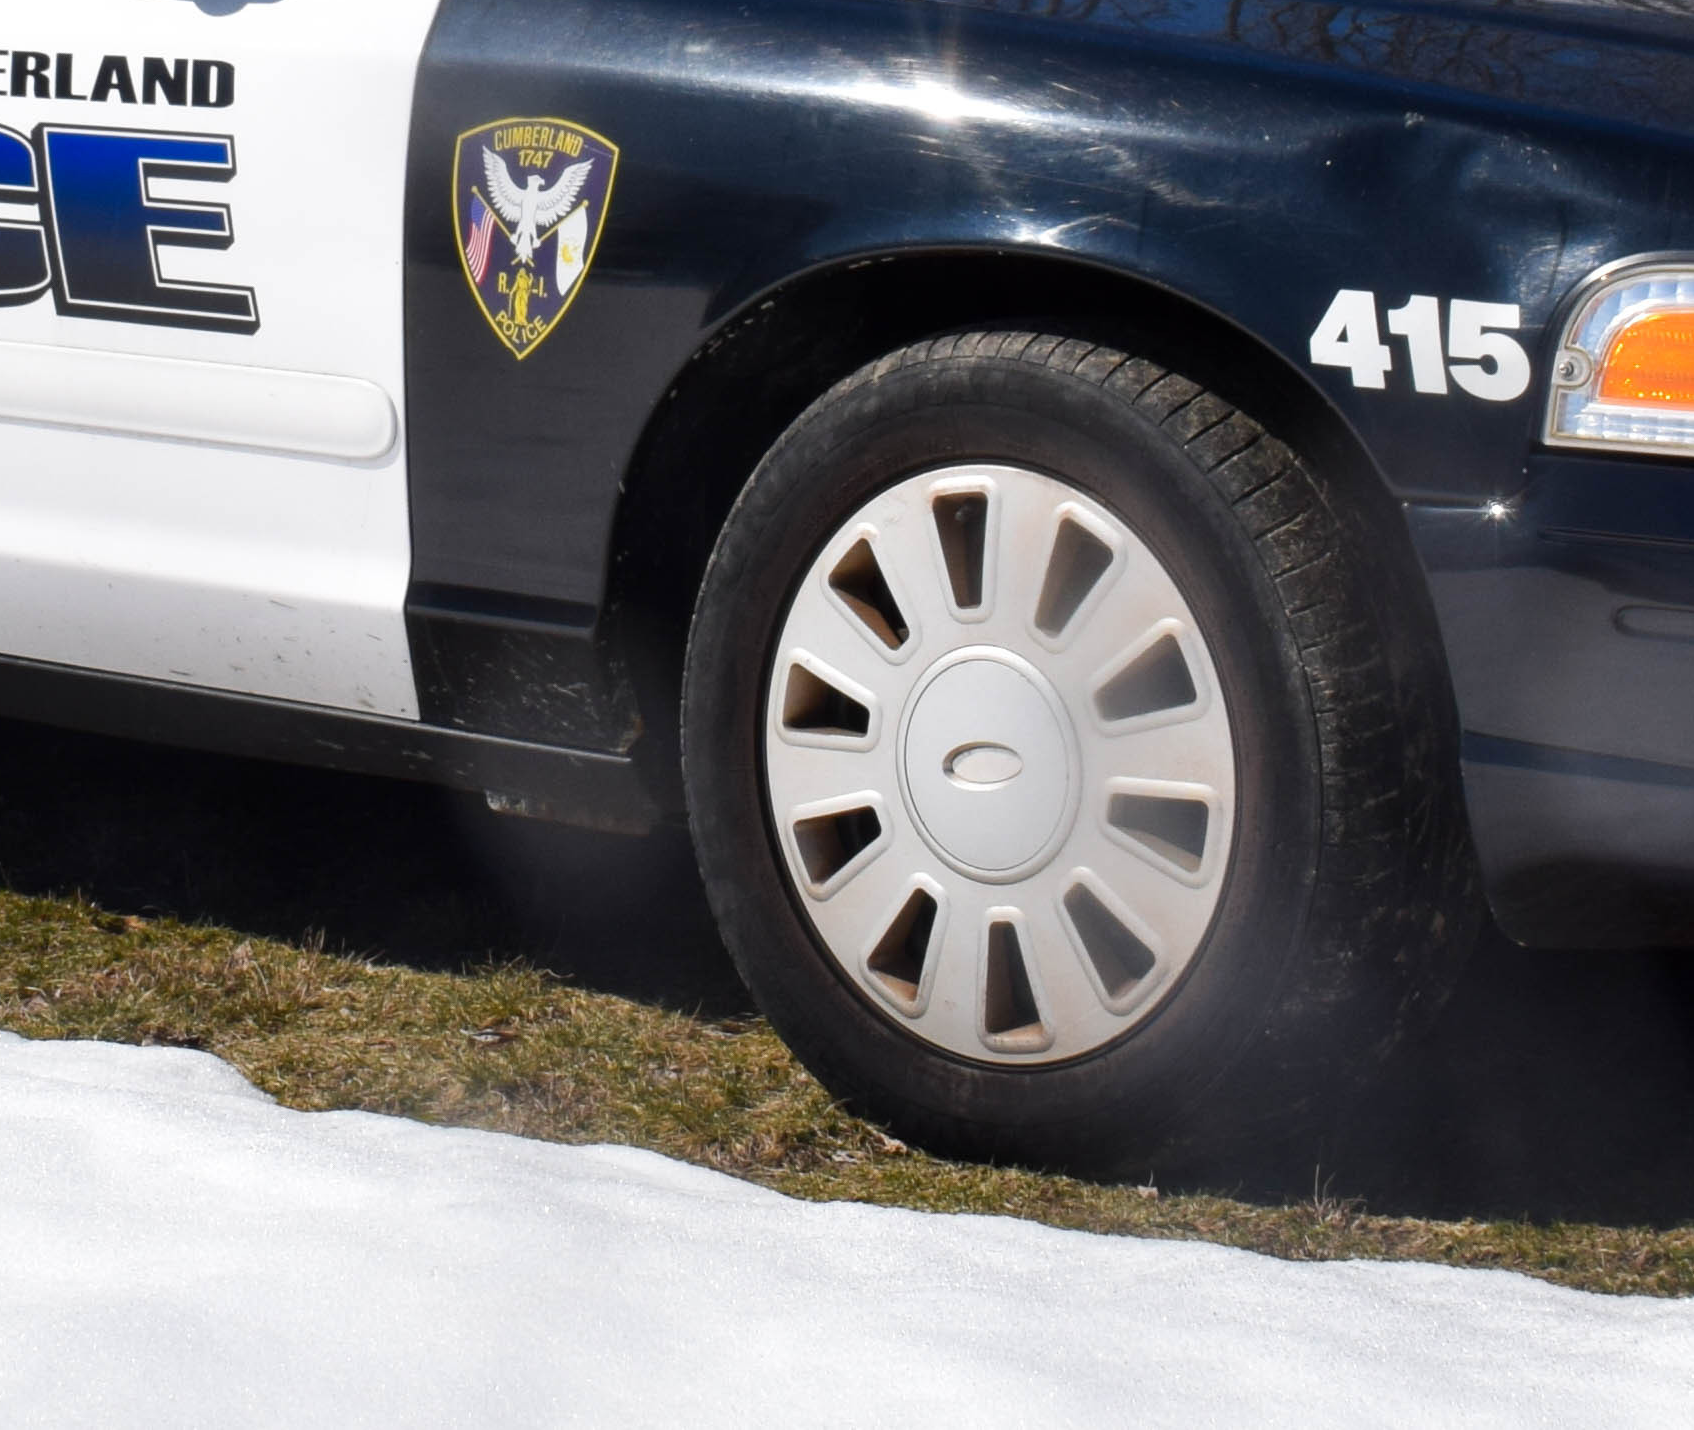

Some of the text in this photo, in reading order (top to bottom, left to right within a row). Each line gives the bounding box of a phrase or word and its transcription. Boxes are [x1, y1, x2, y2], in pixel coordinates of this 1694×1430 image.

[495, 126, 584, 158] CUMBERLAND
[518, 149, 554, 169] 1747
[495, 310, 547, 344] POLICE
[1309, 289, 1531, 402] 415
